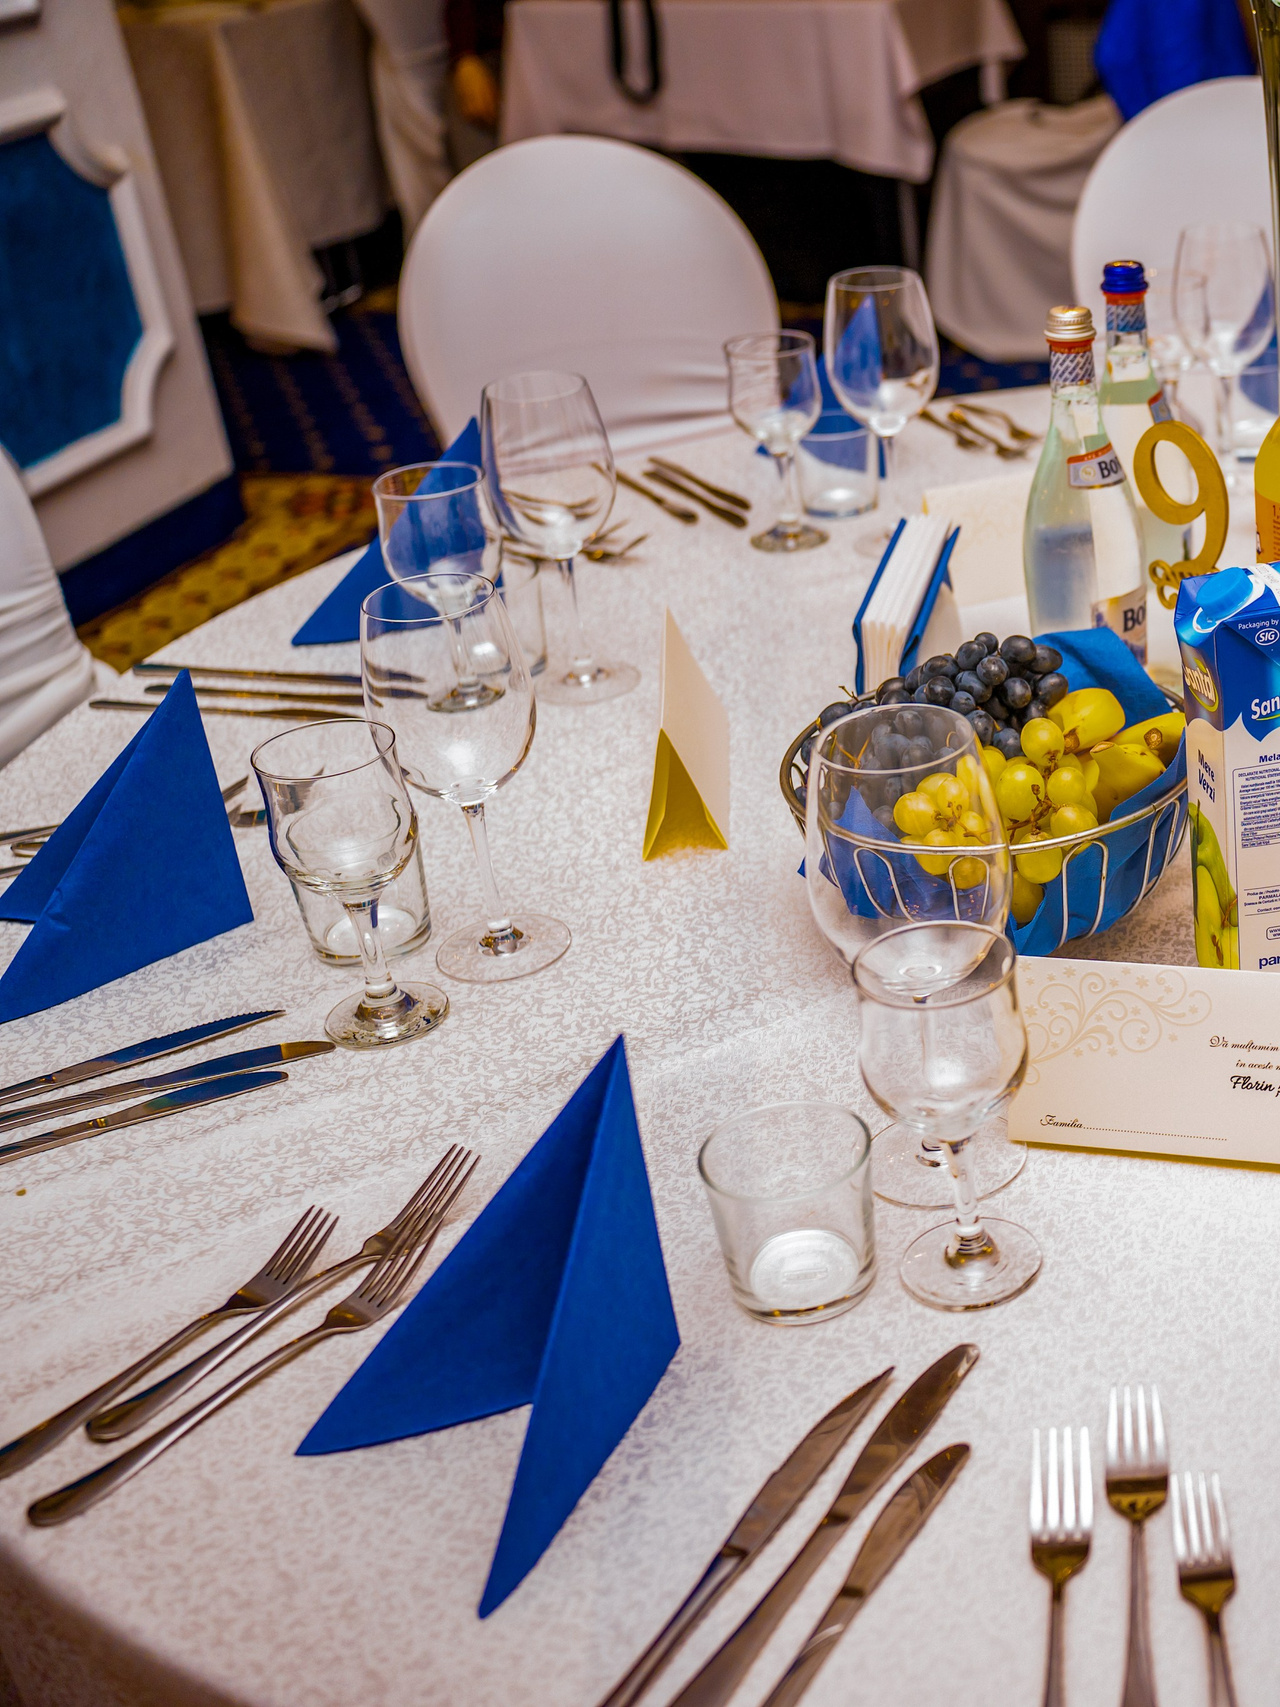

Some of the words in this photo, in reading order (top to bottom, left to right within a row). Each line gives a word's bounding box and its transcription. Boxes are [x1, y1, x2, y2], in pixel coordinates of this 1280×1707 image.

[1133, 420, 1229, 574] 9
[1238, 620, 1270, 630] Packaging
[1271, 618, 1279, 626] by
[1259, 631, 1275, 642] SIG
[1198, 748, 1215, 782] Mere
[1198, 768, 1215, 803] Verzi
[1209, 1035, 1228, 1048] Vă
[1235, 1059, 1246, 1068] în
[1248, 1061, 1274, 1070] aceste
[1229, 1075, 1275, 1093] Florin
